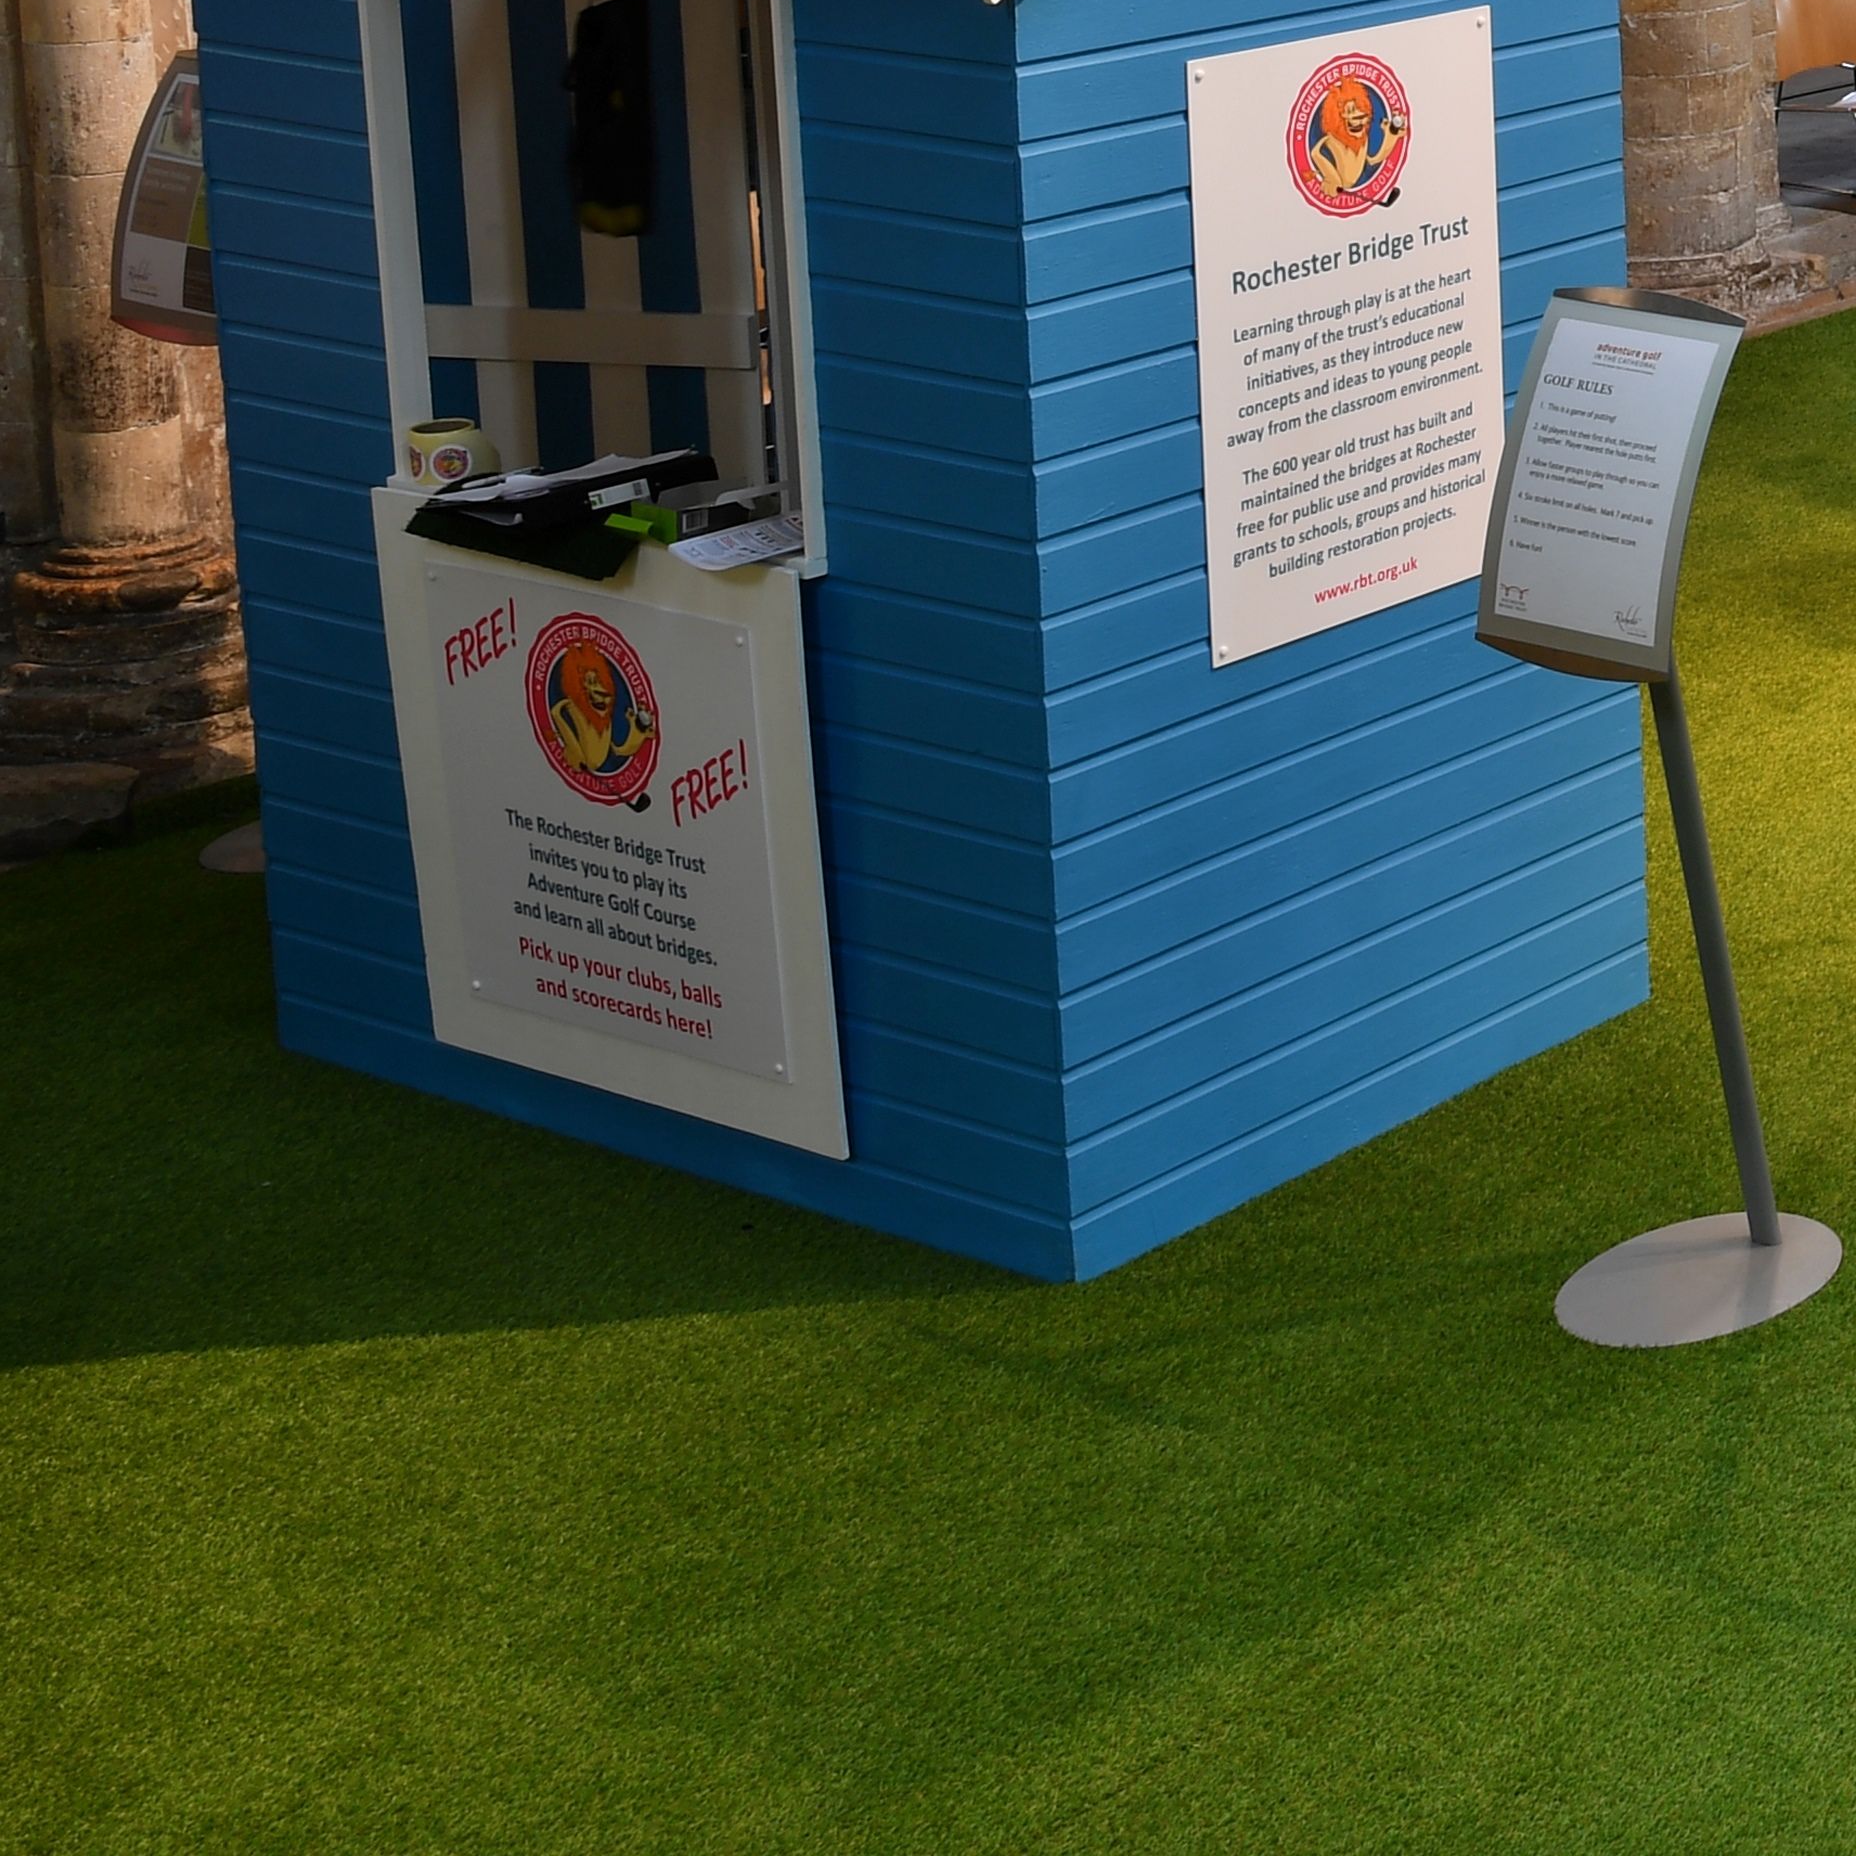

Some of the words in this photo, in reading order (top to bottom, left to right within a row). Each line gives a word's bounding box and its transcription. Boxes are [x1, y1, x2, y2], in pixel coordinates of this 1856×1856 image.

[1296, 68, 1341, 131] ROCHESTER
[1341, 64, 1379, 82] BRIDGE
[1378, 72, 1402, 115] TRUST
[1372, 159, 1395, 191] GOLF
[1232, 251, 1342, 295] Rochester
[1348, 232, 1414, 265] Bridge
[1419, 216, 1469, 246] Trust
[1233, 317, 1294, 344] Learning
[1297, 299, 1351, 327] through
[1354, 294, 1382, 315] play
[1385, 288, 1395, 303] is
[1398, 284, 1412, 299] at
[1414, 279, 1436, 295] the
[1438, 268, 1471, 288] heart
[1243, 347, 1259, 366] of
[1262, 341, 1301, 361] many
[1304, 331, 1318, 350] of
[1321, 328, 1344, 345] the
[1347, 314, 1389, 338] trust's
[1391, 291, 1464, 326] educational
[1238, 391, 1301, 419] concepts
[1304, 379, 1330, 401] and
[1333, 372, 1368, 392] ideas
[1371, 367, 1385, 381] to
[1388, 355, 1428, 379] young
[1430, 340, 1472, 367] people
[1247, 362, 1319, 391] initiatives,
[1322, 356, 1337, 370] as
[1340, 347, 1370, 365] they
[1373, 328, 1434, 356] introduce
[1437, 320, 1464, 337] new
[1543, 373, 1575, 389] GOLF
[1576, 377, 1614, 396] RULES
[1596, 343, 1642, 358] adventure
[1642, 351, 1663, 362] golf
[1227, 427, 1265, 448] away
[1267, 416, 1302, 436] from
[1305, 408, 1328, 425] the
[1331, 388, 1397, 417] classroom
[1400, 361, 1483, 397] environment.
[1241, 473, 1319, 512] maintained
[1323, 469, 1346, 486] the
[1348, 453, 1397, 478] bridges
[1399, 447, 1412, 462] at
[1416, 427, 1477, 457] Rochester
[1242, 468, 1269, 485] The
[1272, 456, 1298, 477] 600
[1301, 449, 1331, 471] year
[1334, 437, 1356, 458] old
[1358, 429, 1390, 450] trust
[1393, 423, 1415, 440] has
[1418, 411, 1447, 432] built
[1450, 401, 1473, 422] and
[1233, 541, 1277, 568] grants
[1280, 535, 1295, 550] to
[1298, 516, 1353, 544] schools,
[1355, 500, 1400, 528] groups
[1403, 488, 1427, 509] and
[1430, 469, 1486, 500] historical
[1236, 520, 1265, 538] free
[1268, 512, 1289, 528] for
[1292, 496, 1333, 524] public
[1336, 490, 1360, 506] use
[1363, 476, 1388, 498] and
[1391, 462, 1445, 493] provides
[1448, 450, 1482, 470] many
[1269, 550, 1324, 578] building
[1327, 525, 1399, 559] restoration
[1402, 507, 1457, 537] projects.
[1314, 556, 1418, 604] www.rbt.org.uk
[444, 596, 517, 686] FREE!
[535, 626, 581, 681] ROCHESTER
[581, 626, 621, 659] BRIDGE
[621, 658, 649, 704] TRUST
[670, 738, 748, 827] FREE!
[505, 808, 533, 831] The
[536, 816, 610, 850] Rochester
[613, 835, 663, 866] Bridge
[665, 848, 706, 875] Trust
[528, 842, 578, 872] invites
[580, 860, 609, 880] you
[612, 866, 629, 885] to
[632, 871, 665, 898] play
[667, 877, 688, 900] its
[514, 900, 542, 920] and
[544, 904, 583, 931] learn
[586, 917, 604, 937] all
[608, 923, 653, 950] about
[655, 933, 718, 967] bridges.
[527, 872, 604, 908] Adventure
[607, 893, 640, 917] Golf
[643, 902, 696, 932] Course
[519, 936, 554, 963] Pick
[557, 951, 579, 974] up
[583, 958, 622, 982] your
[627, 966, 677, 1000] clubs,
[680, 978, 722, 1009] balls
[536, 978, 568, 999] and
[572, 987, 662, 1026] scorecards
[665, 1007, 713, 1040] here!
